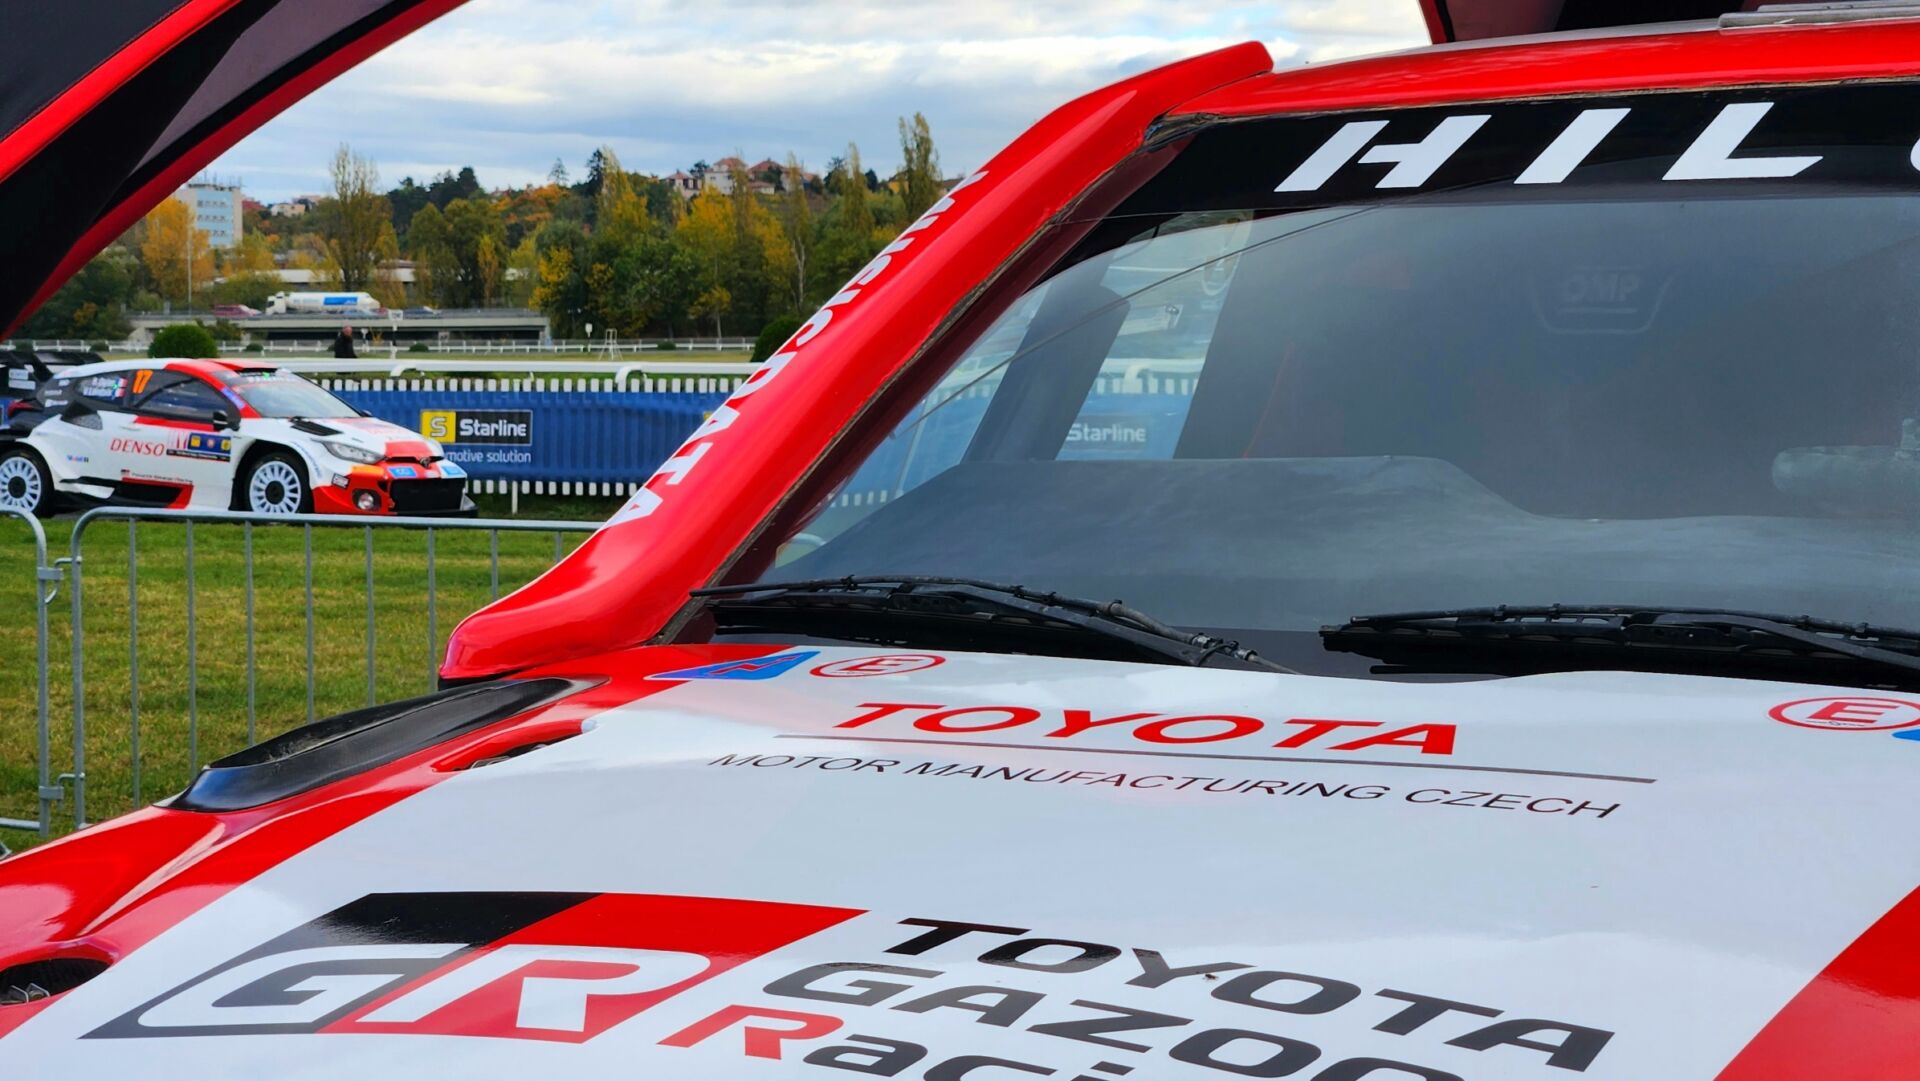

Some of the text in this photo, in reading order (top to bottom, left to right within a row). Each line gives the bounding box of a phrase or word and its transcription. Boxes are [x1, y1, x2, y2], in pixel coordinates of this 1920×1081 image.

[1273, 101, 1920, 192] HIL
[1559, 272, 1641, 303] OMP
[132, 369, 154, 394] 17
[459, 418, 527, 437] Starline
[1066, 423, 1147, 443] Starline
[110, 438, 165, 457] DENSO
[443, 448, 532, 464] motive solution
[834, 701, 1459, 756] TOYOTA
[707, 754, 1622, 819] MOTOR MANUFACTURING CZECH
[136, 942, 711, 1033] GR
[884, 916, 1615, 1073] TOYOTA
